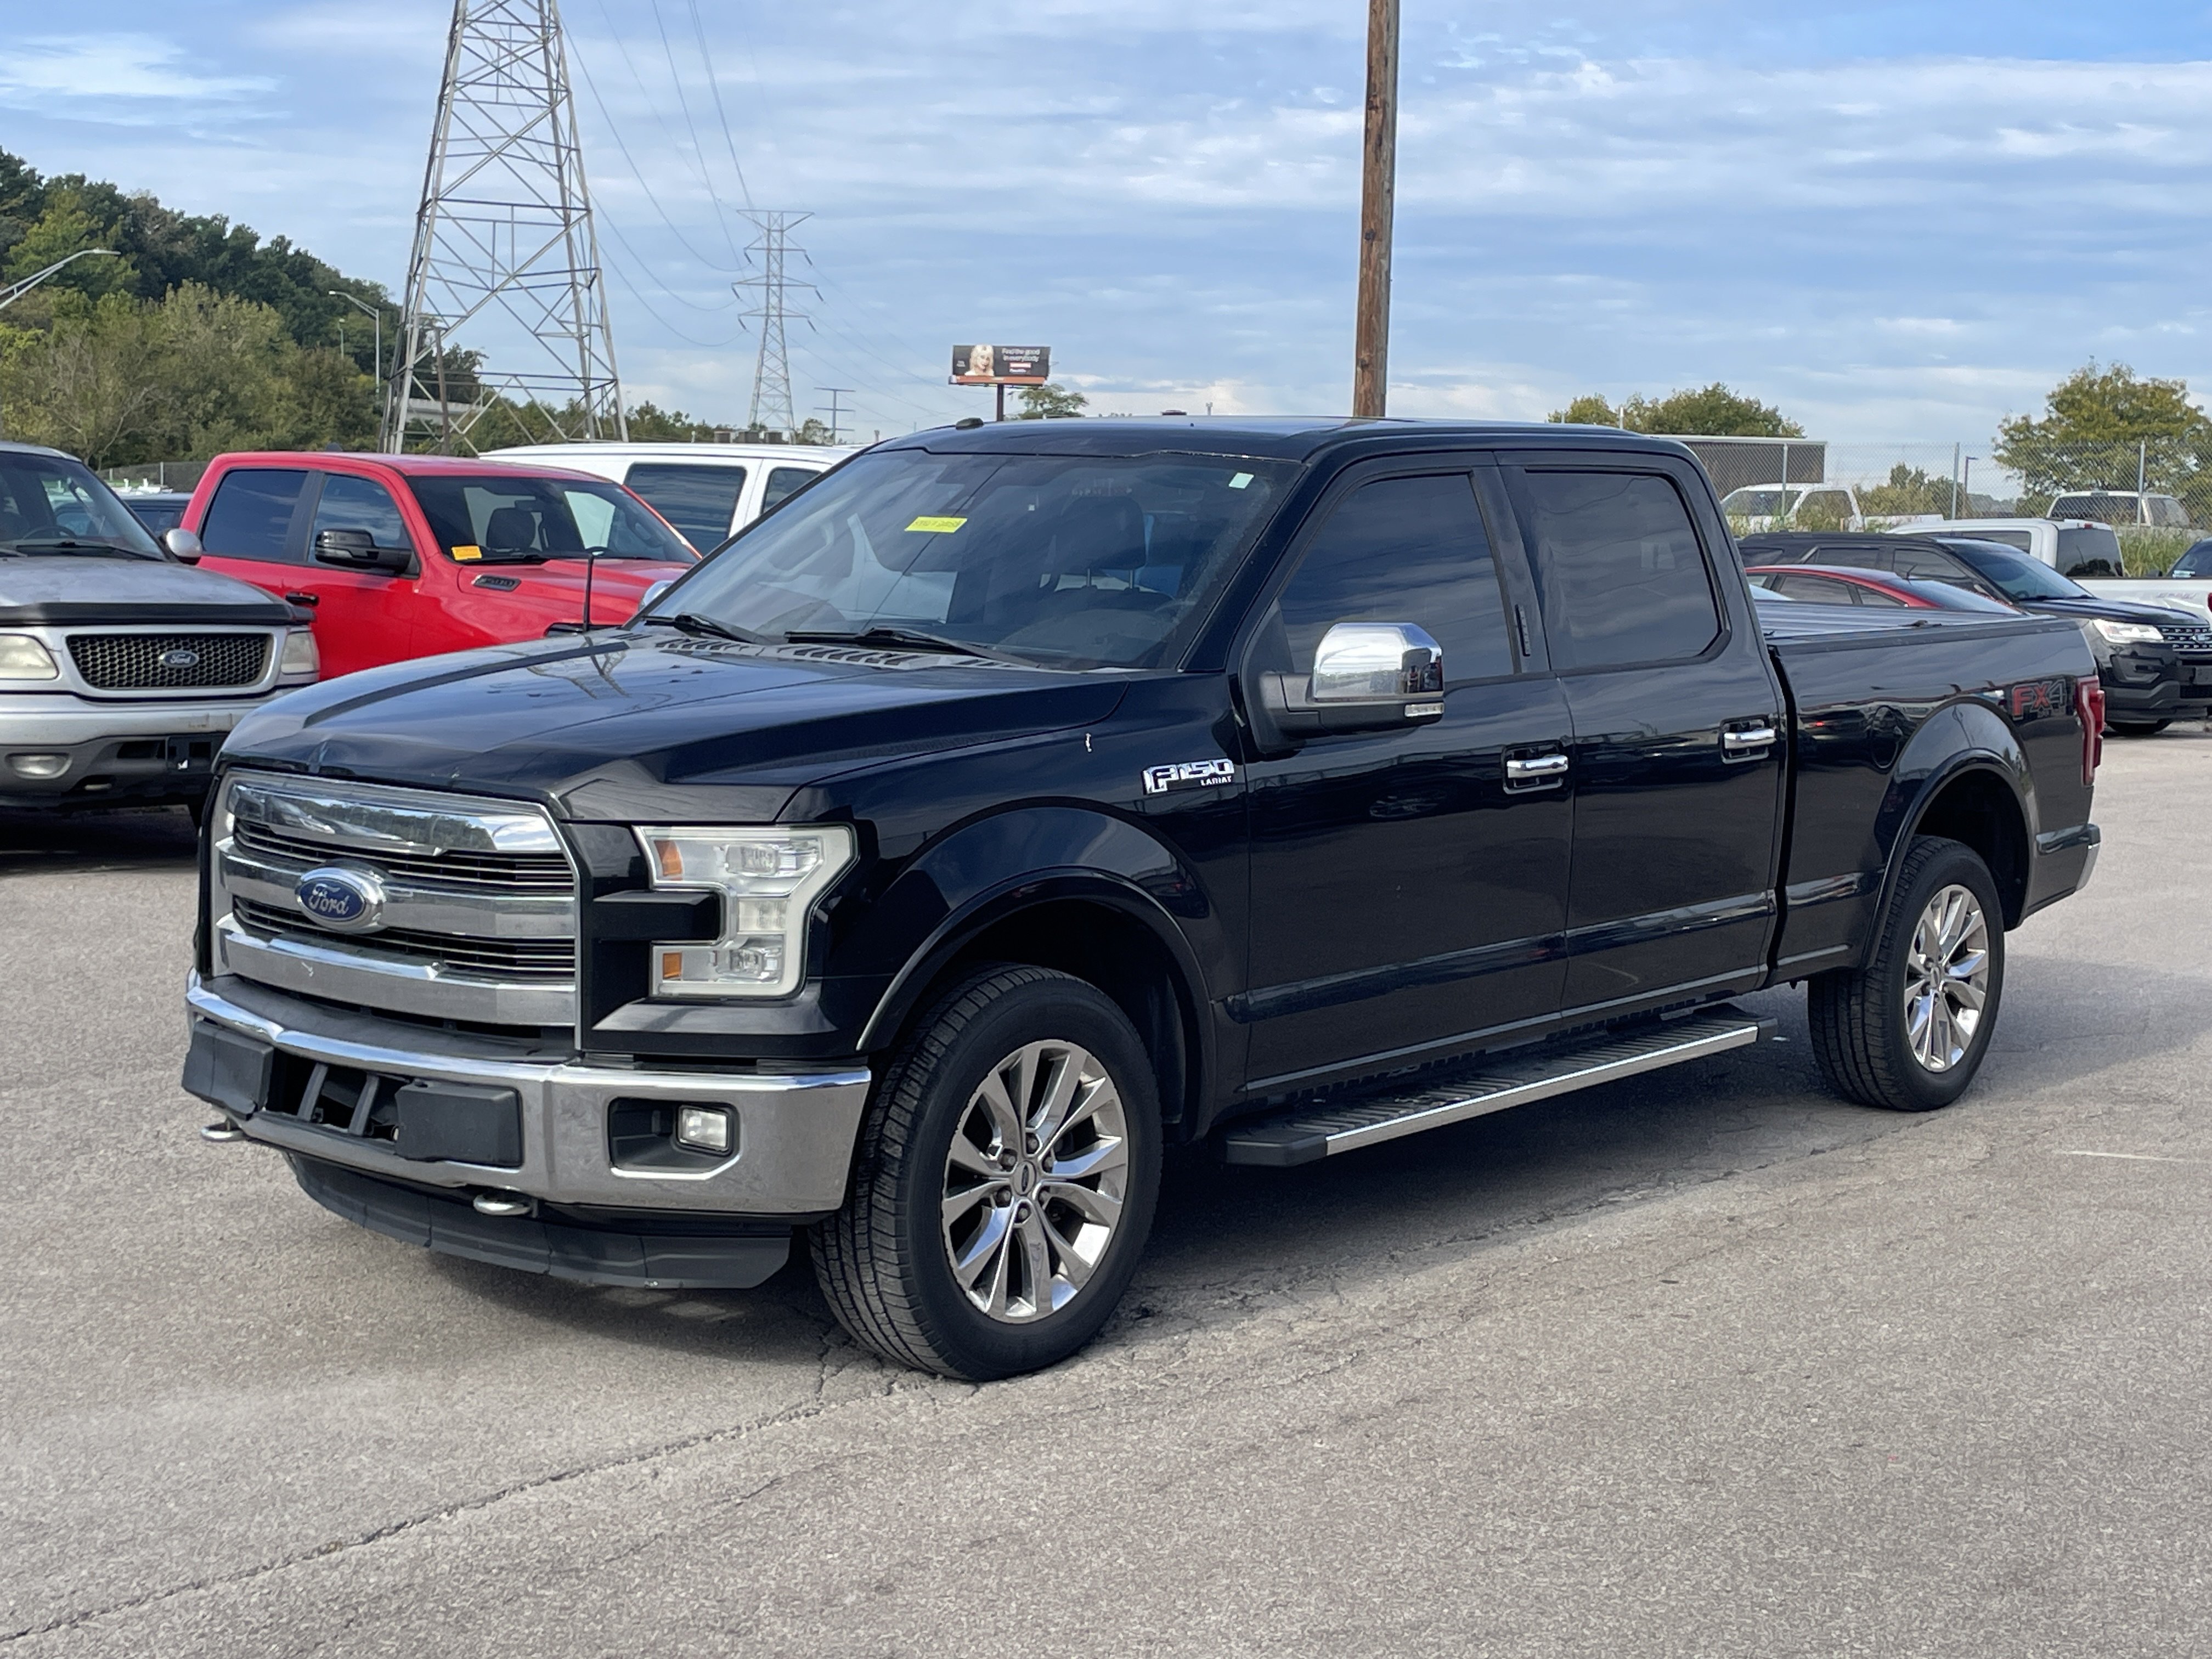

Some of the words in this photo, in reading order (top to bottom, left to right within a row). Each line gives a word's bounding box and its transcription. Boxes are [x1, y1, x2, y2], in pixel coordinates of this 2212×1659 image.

[170, 653, 191, 664] Ford
[2011, 679, 2067, 721] FX4
[1200, 776, 1232, 786] LARIAT
[308, 883, 350, 915] Ford
